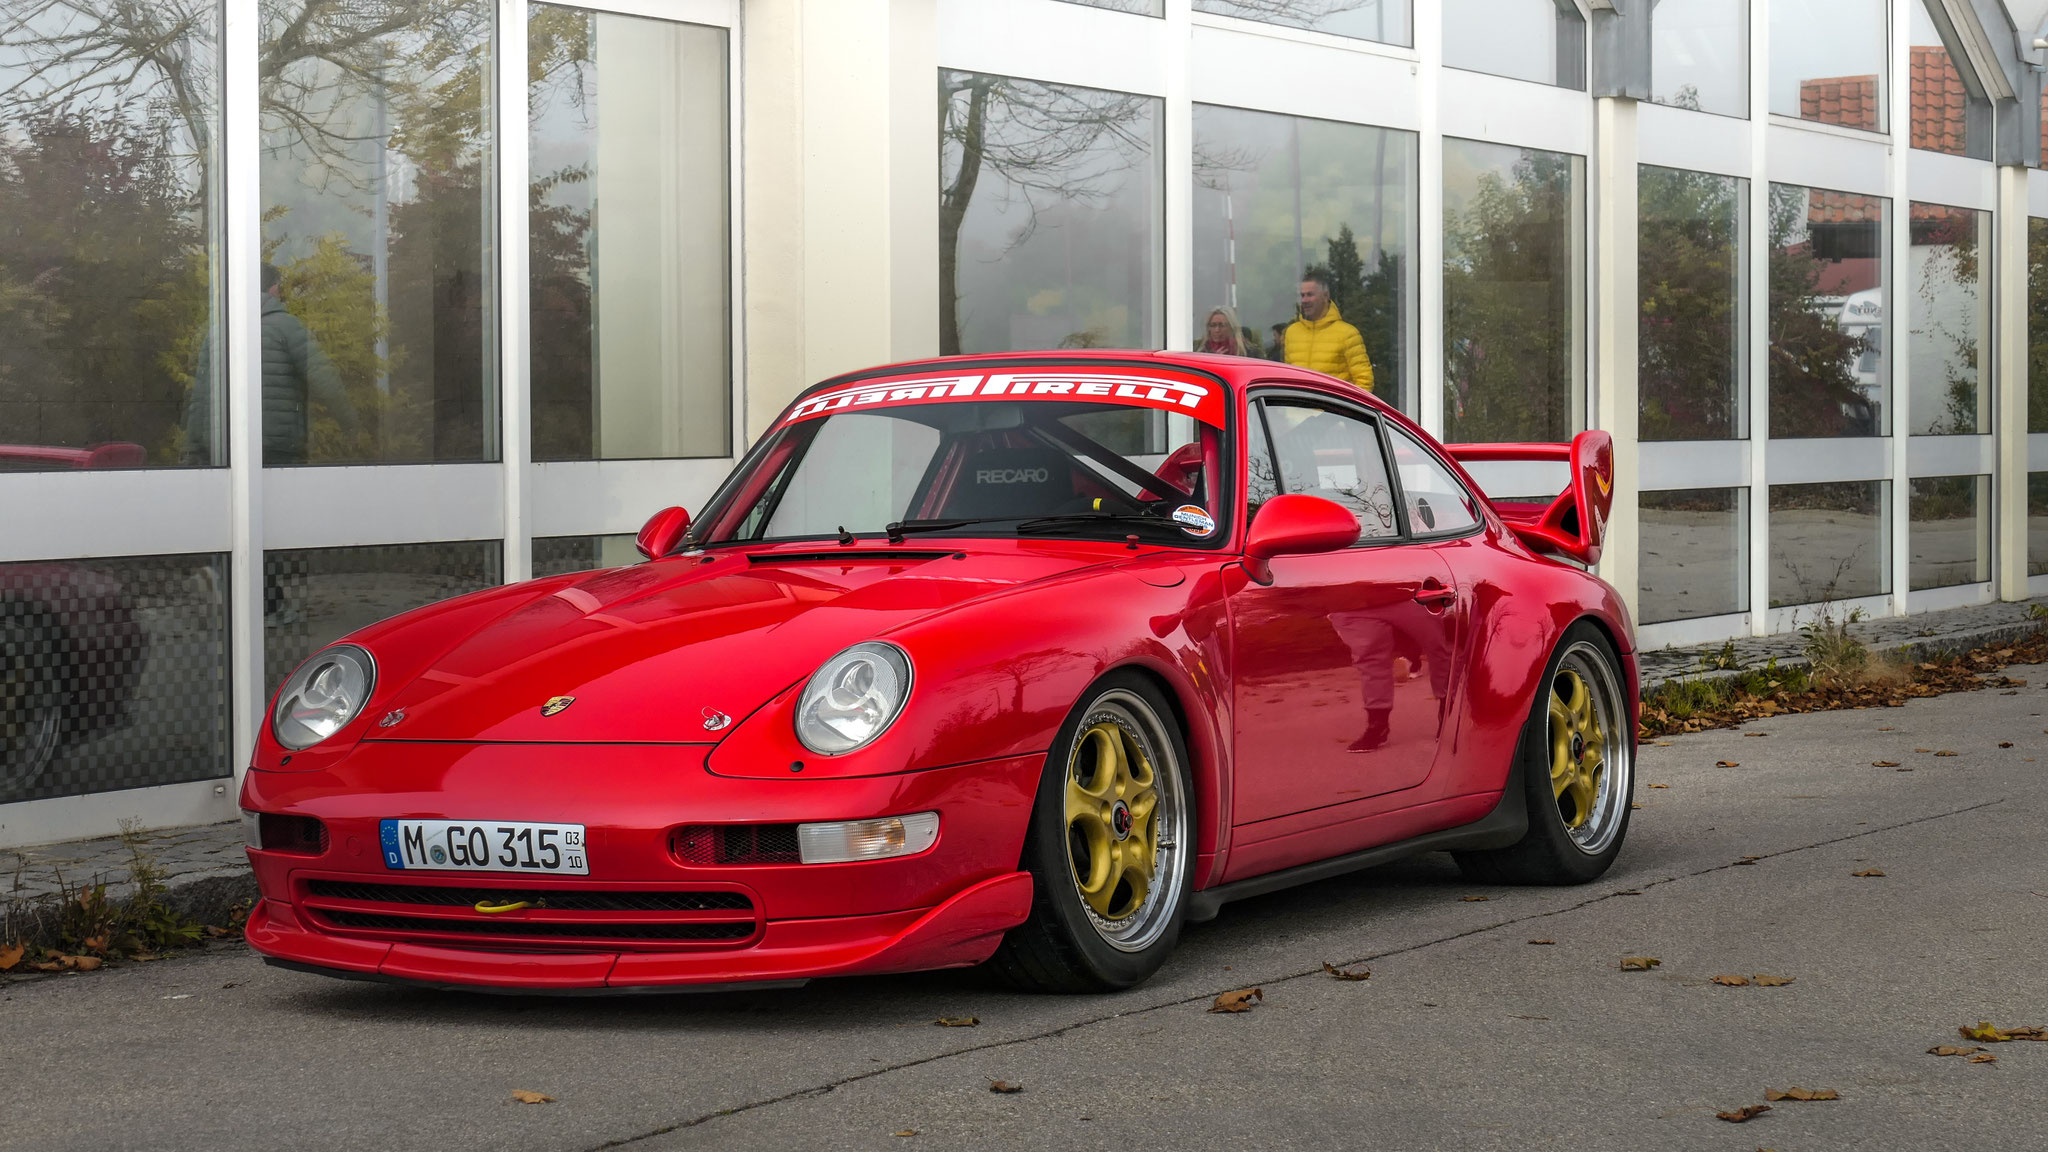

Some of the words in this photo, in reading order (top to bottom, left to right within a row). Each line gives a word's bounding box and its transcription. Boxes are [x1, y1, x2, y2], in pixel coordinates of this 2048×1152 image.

[980, 373, 1209, 408] PIRELLI
[976, 467, 1049, 484] RECARO
[1174, 514, 1214, 528] GENTLEMAN
[565, 831, 580, 845] 03
[404, 825, 428, 865] M
[446, 826, 490, 867] GO
[497, 827, 561, 869] 315
[389, 852, 398, 864] D
[568, 855, 583, 869] 10
